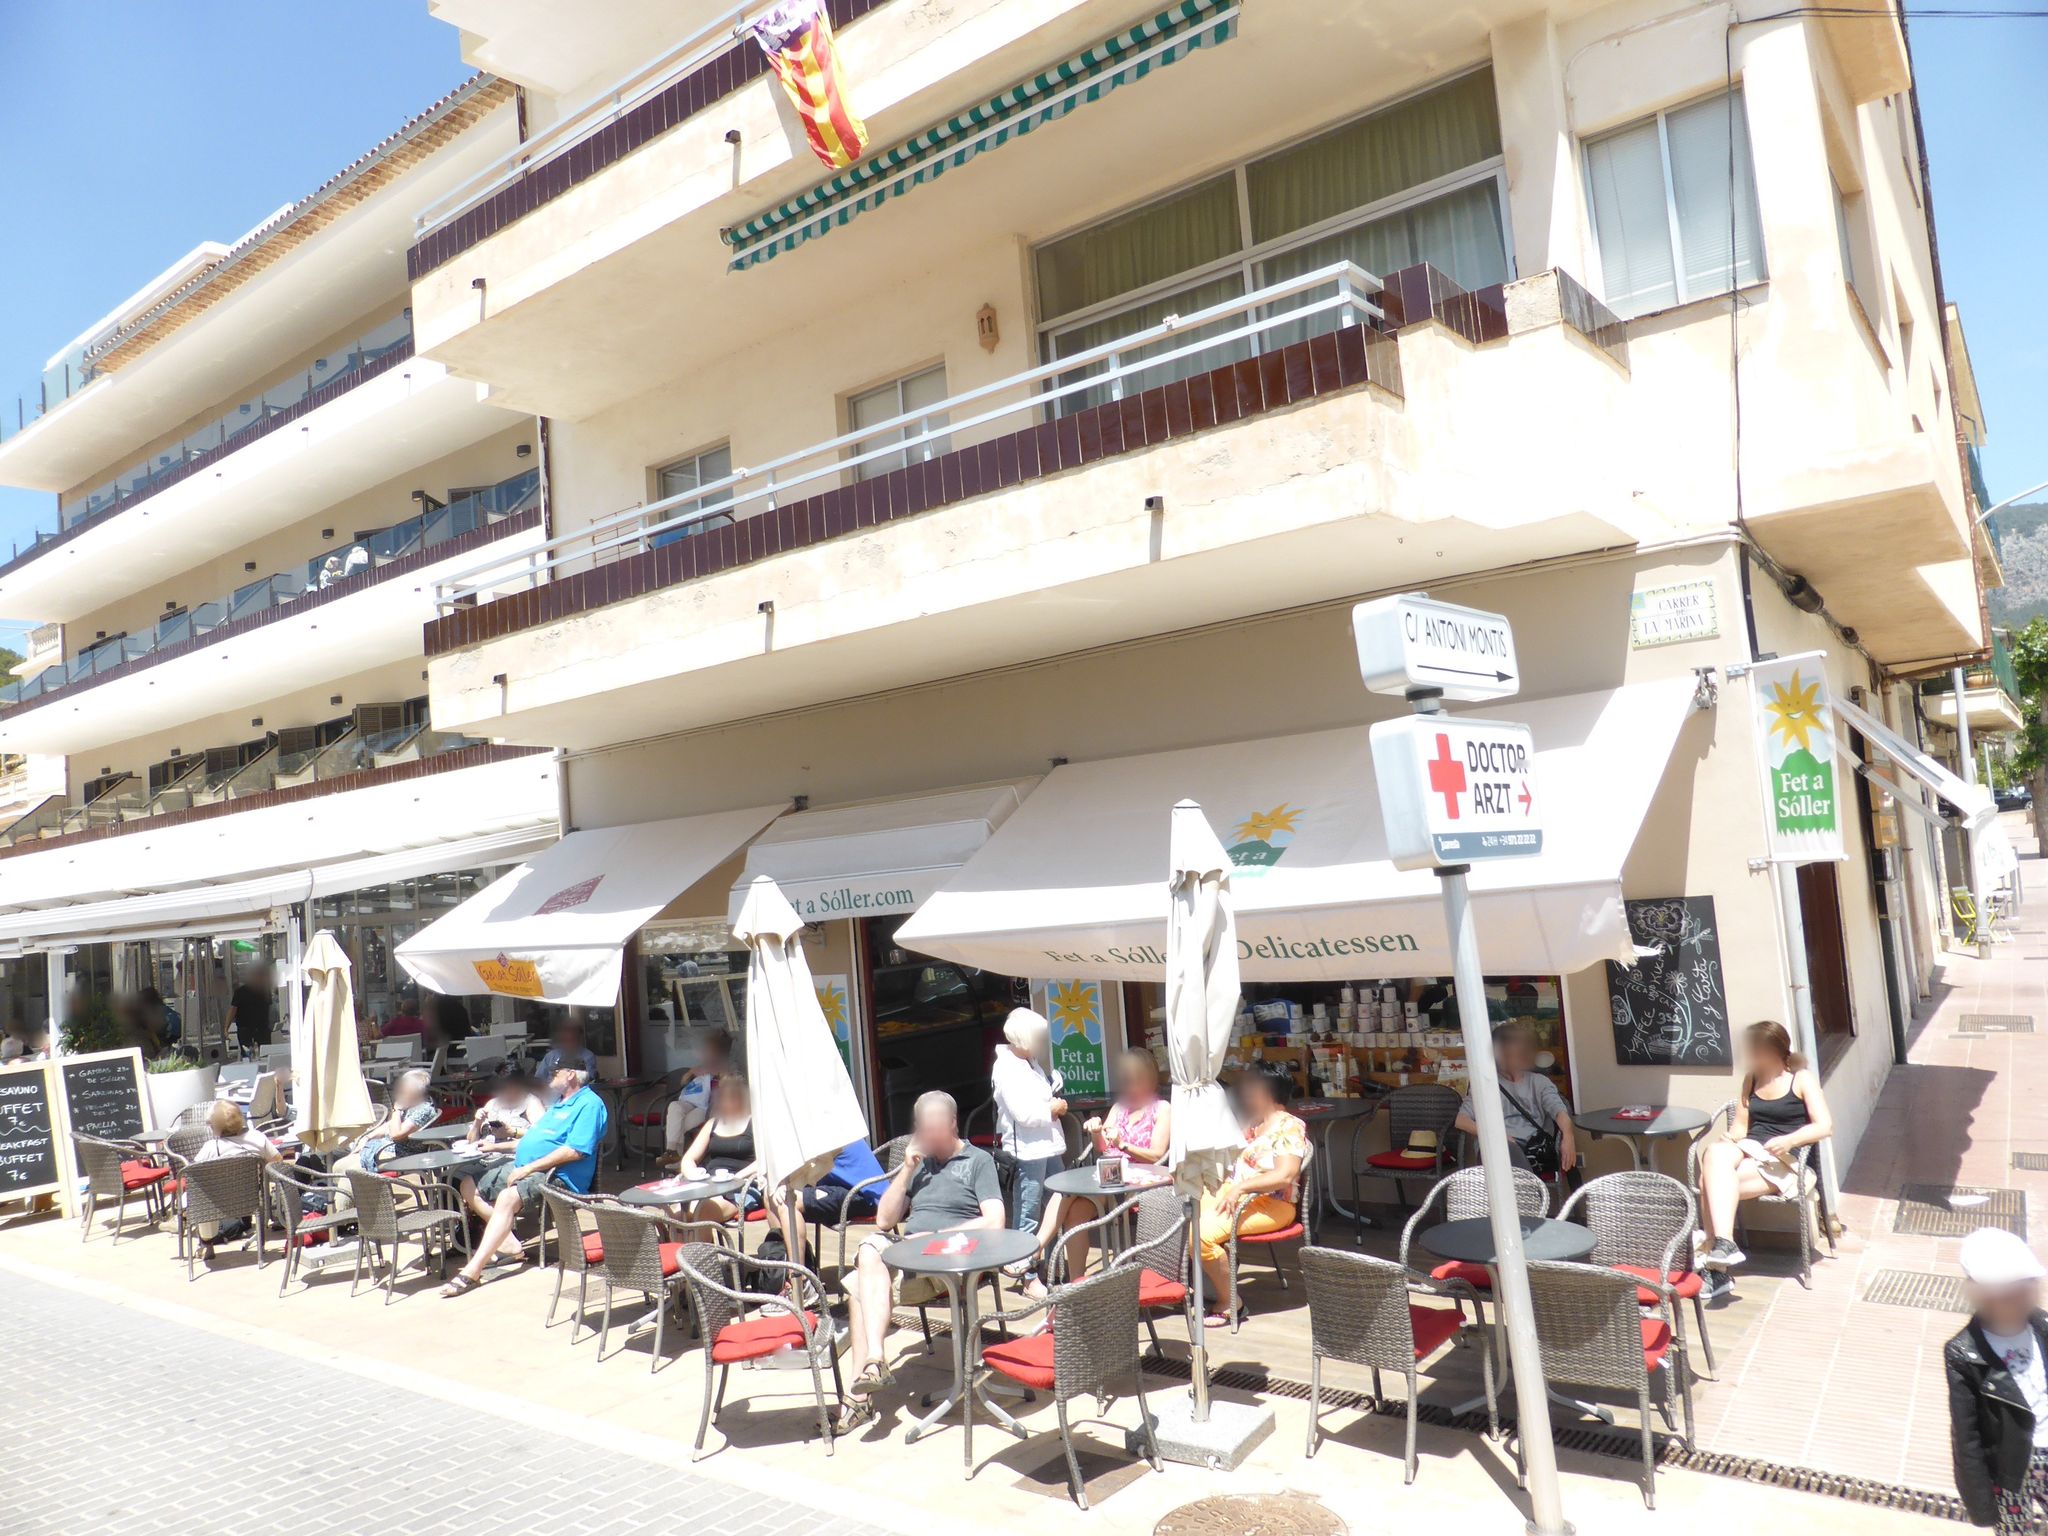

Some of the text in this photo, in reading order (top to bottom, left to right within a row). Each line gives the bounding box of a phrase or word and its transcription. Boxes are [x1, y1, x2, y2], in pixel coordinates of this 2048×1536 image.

[1658, 594, 1700, 611] CARRER
[1405, 612, 1507, 658] C/ ANTONI MONTIS
[1643, 614, 1704, 635] LA MARINA
[1466, 740, 1528, 775] DOCTOR
[1780, 773, 1825, 793] Fet a
[1474, 782, 1511, 815] ARZT
[1778, 793, 1831, 818] Sóller
[790, 887, 914, 915] et a Sóller.com
[1043, 929, 1420, 965] Fet a Sólle Delicatessen
[1060, 1048, 1095, 1063] Fet a
[1058, 1064, 1101, 1081] Sóller
[0, 1085, 38, 1096] SAYUNO
